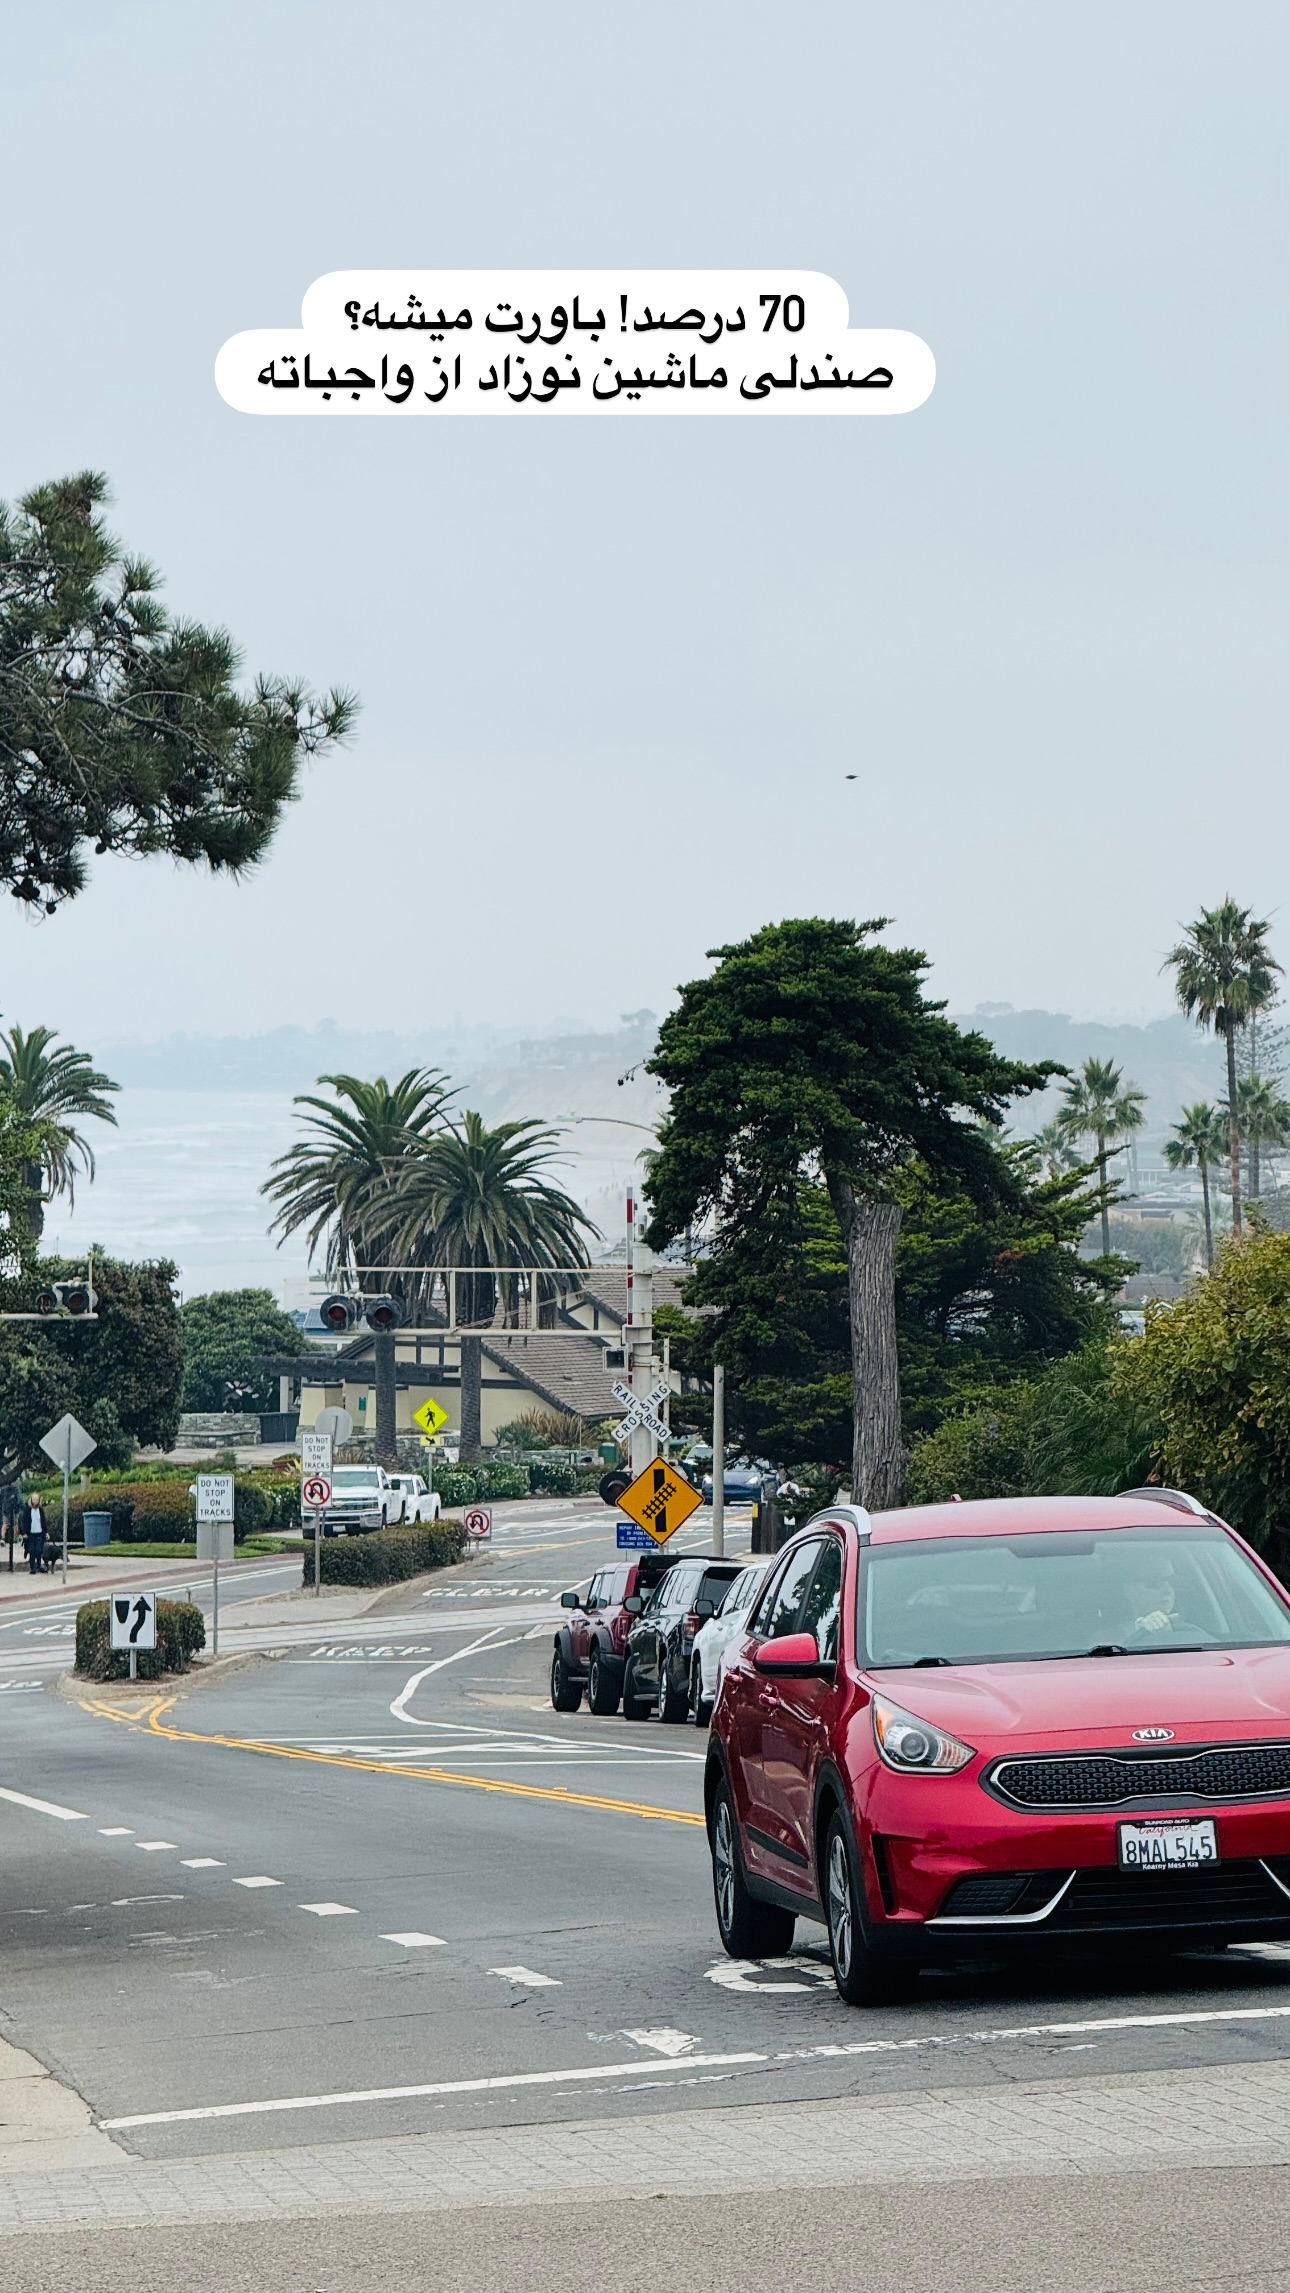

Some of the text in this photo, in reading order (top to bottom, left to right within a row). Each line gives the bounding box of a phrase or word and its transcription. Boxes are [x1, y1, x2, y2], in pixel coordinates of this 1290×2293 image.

[615, 1385, 667, 1439] CROSSING
[200, 1479, 230, 1487] DO NOT
[205, 1489, 226, 1497] STOP
[200, 1508, 231, 1516] TRACKS
[421, 1588, 550, 1597] CLEAR
[309, 1646, 433, 1657] KEEP
[1138, 1728, 1169, 1739] KIA
[1138, 1825, 1198, 1837] California
[1125, 1835, 1214, 1863] 8MAL545
